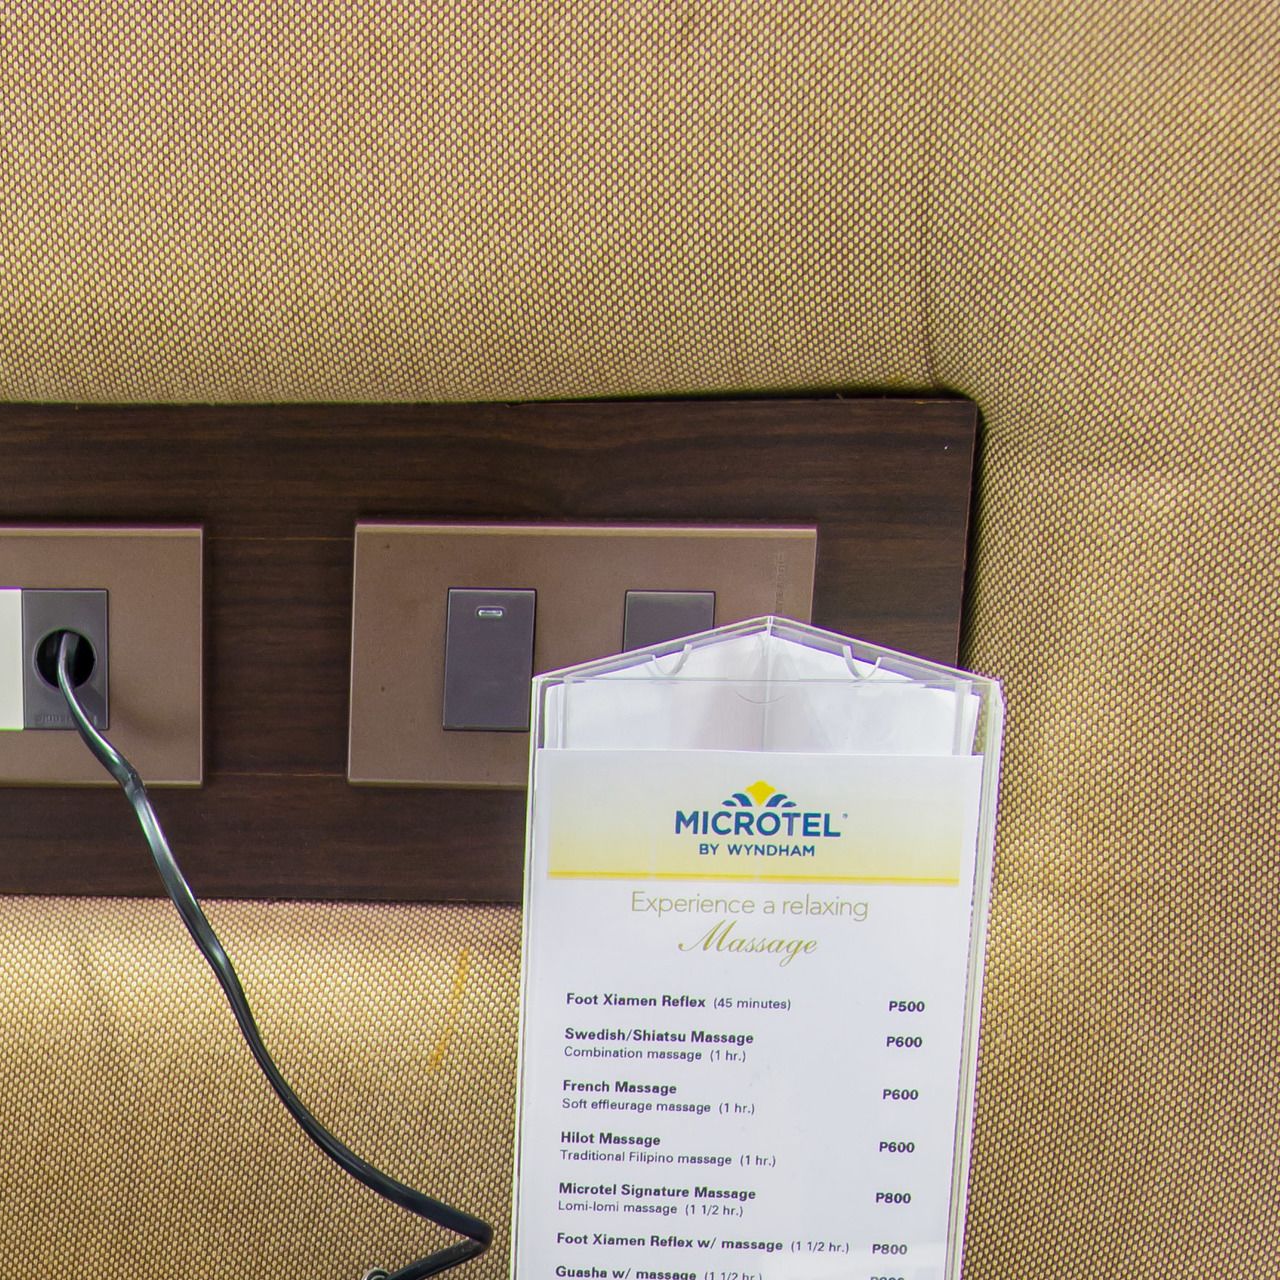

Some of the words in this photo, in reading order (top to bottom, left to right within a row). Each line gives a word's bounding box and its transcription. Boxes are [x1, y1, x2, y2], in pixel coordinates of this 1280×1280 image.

[675, 810, 841, 838] MICROTEL
[698, 843, 720, 855] BY
[727, 844, 815, 857] WYNDHAM
[631, 891, 755, 918] Experience
[762, 900, 776, 915] a
[782, 893, 869, 922] relaxing
[678, 919, 818, 967] Massage
[566, 992, 599, 1006] Foot
[602, 993, 657, 1007] Xiamen
[661, 994, 706, 1008] Reflex
[713, 997, 733, 1010] (45
[736, 999, 792, 1012] minutes)
[888, 1000, 926, 1013] P500
[564, 1027, 687, 1043] Swedish/Shiatsu
[690, 1030, 754, 1047] Massage
[886, 1036, 923, 1048] P600
[564, 1045, 643, 1059] Combination
[646, 1050, 703, 1063] massage
[562, 1079, 610, 1093] French
[614, 1080, 677, 1097] Massage
[882, 1088, 919, 1101] P600
[562, 1097, 588, 1110] Soft
[590, 1098, 653, 1114] effleurage
[656, 1103, 711, 1116] massage
[560, 1131, 595, 1144] Hilot
[599, 1132, 661, 1149] Massage
[879, 1141, 916, 1154] P600
[559, 1149, 626, 1162] Traditional
[628, 1151, 674, 1165] Filipino
[677, 1155, 733, 1167] massage
[558, 1182, 617, 1196] Microtel
[620, 1183, 690, 1199] Signature
[694, 1186, 756, 1202] Massage
[875, 1192, 912, 1204] P800
[558, 1199, 619, 1212] Lomi-lomi
[623, 1204, 678, 1217] massage
[556, 1232, 589, 1245] Foot
[592, 1233, 646, 1247] Xiamen
[650, 1234, 694, 1248] Reflex
[697, 1237, 717, 1250] w/
[721, 1240, 784, 1253] massage
[872, 1243, 908, 1255] P800
[555, 1265, 608, 1279] Guasha
[611, 1267, 632, 1280] w/
